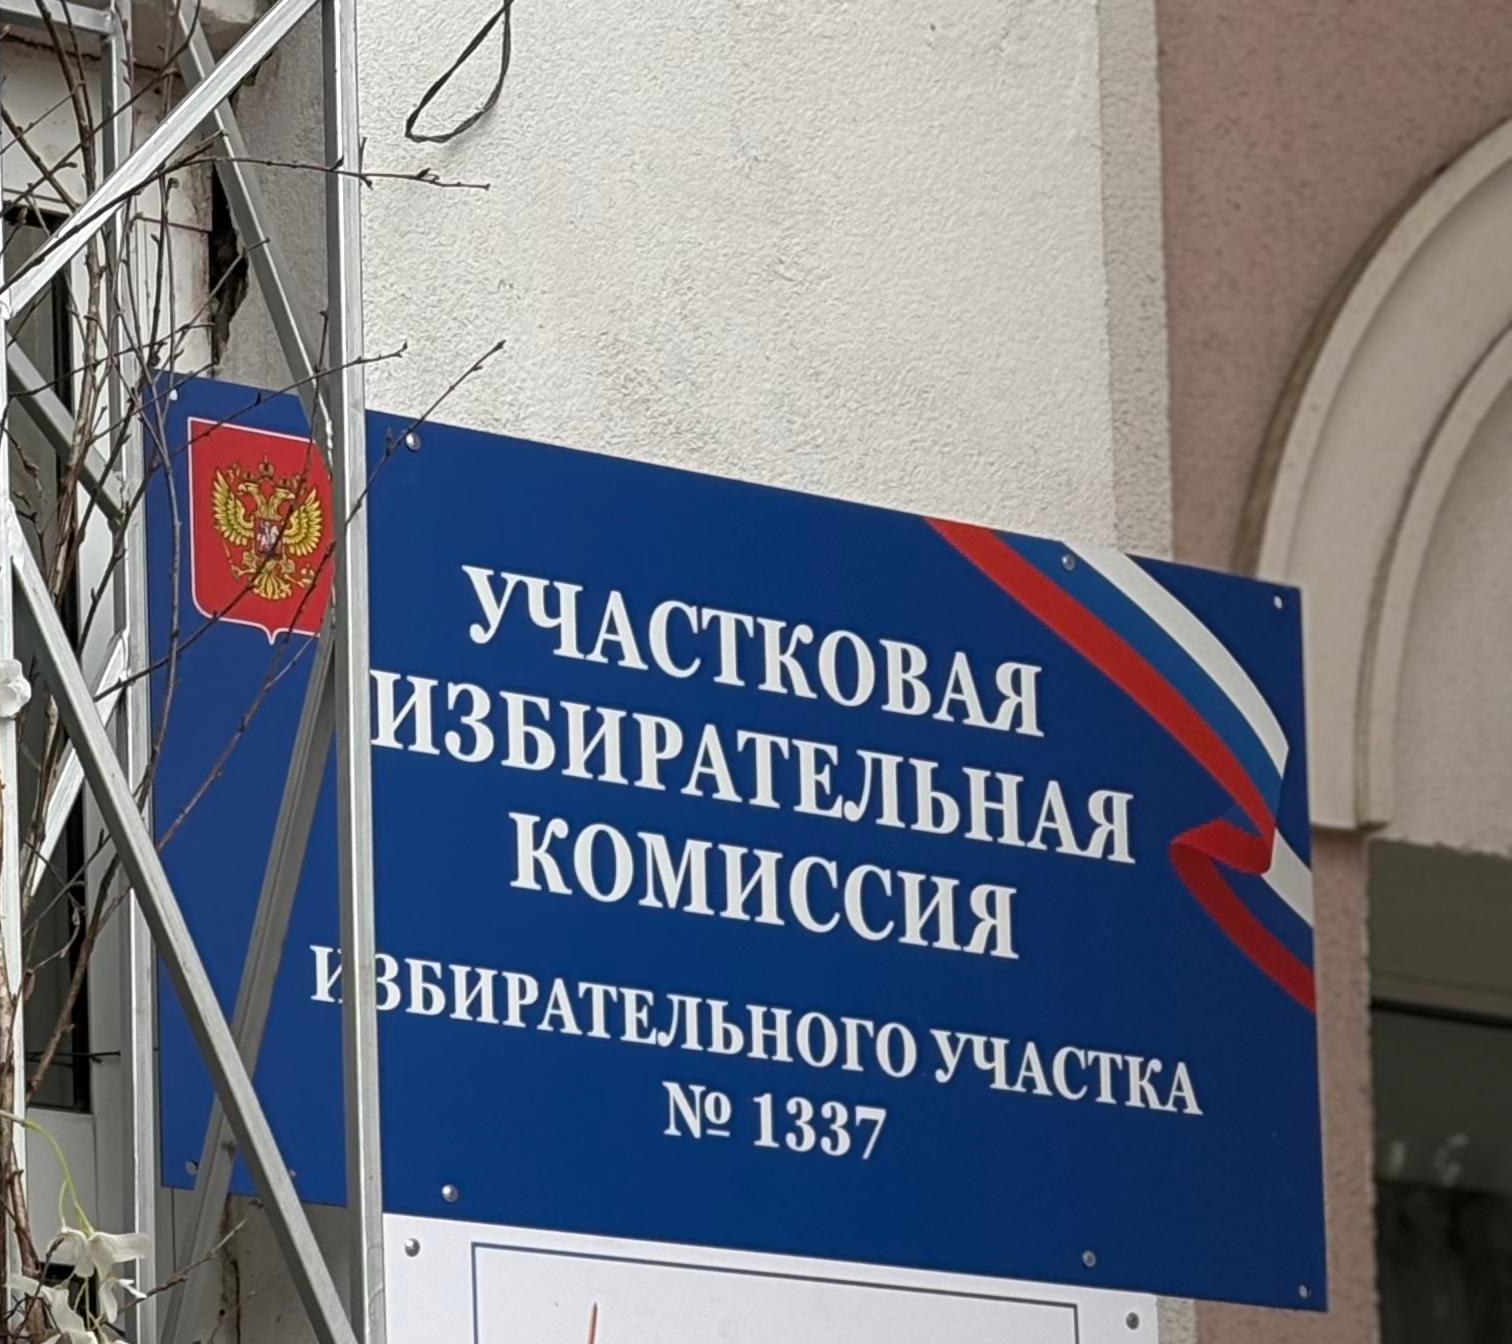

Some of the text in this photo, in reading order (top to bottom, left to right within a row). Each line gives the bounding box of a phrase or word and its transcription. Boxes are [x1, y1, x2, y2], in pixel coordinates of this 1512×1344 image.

[461, 565, 1045, 737] УЧАСТКОВАЯ
[370, 669, 1136, 865] ИЗБИРАТЕЛЬНАЯ
[508, 811, 1020, 960] КОМИССИЯ
[662, 1080, 887, 1160] № 1337
[930, 1029, 1204, 1116] УЧАСТКА
